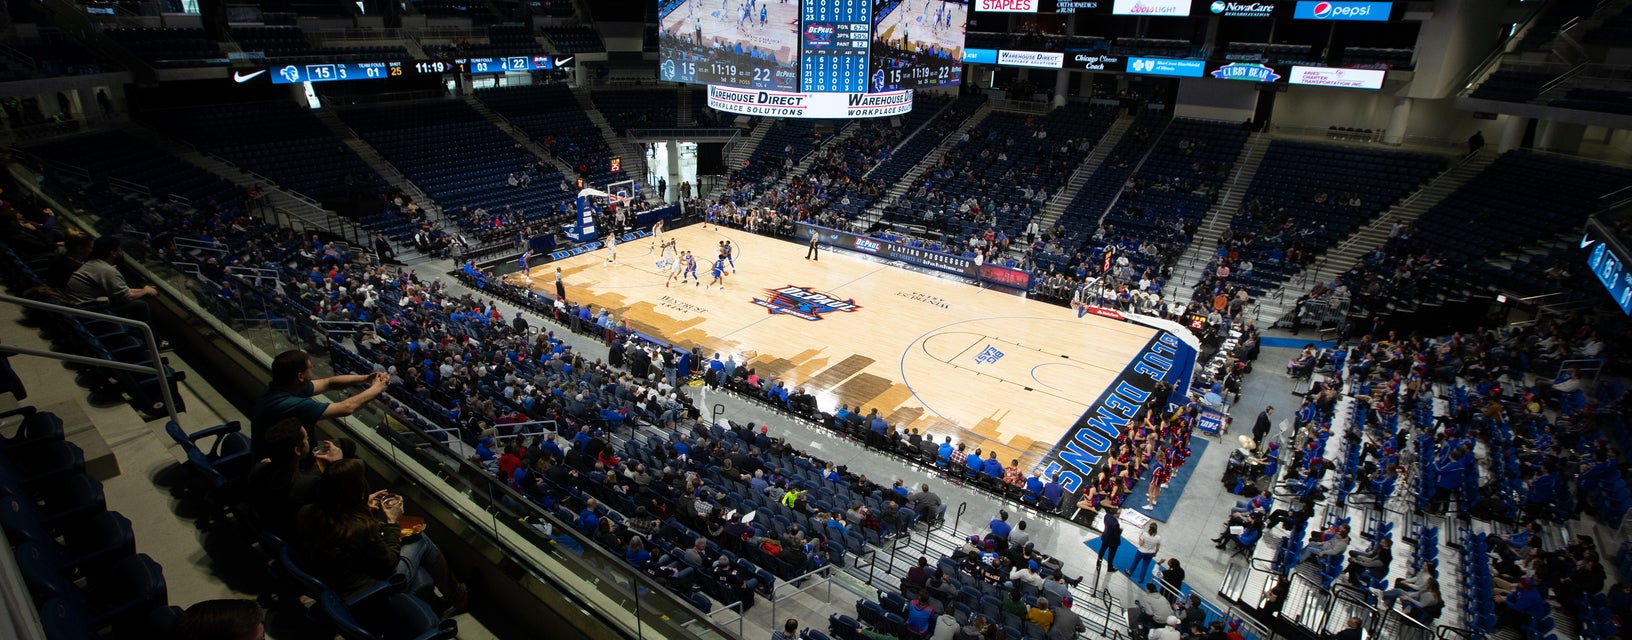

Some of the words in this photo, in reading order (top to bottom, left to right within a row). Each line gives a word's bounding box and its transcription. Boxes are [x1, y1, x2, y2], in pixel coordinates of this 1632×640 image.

[983, 0, 1030, 10] STAPLES
[1225, 2, 1274, 12] NovaCare
[1332, 5, 1371, 17] pepsi
[1002, 52, 1035, 60] WAREHOUSE
[415, 62, 444, 73] 11:19
[460, 64, 464, 72] 1
[477, 63, 487, 71] 03
[501, 62, 507, 70] 4
[513, 59, 524, 69] 22
[682, 62, 696, 75] 15
[711, 63, 737, 76] 11:19
[315, 67, 330, 78] 15
[340, 69, 347, 79] 3
[366, 67, 380, 77] 01
[390, 67, 402, 76] 25
[753, 68, 770, 81] 22
[891, 70, 901, 83] 15
[913, 67, 930, 78] 11:19
[938, 66, 949, 78] 22
[1223, 67, 1247, 76] CUBBY
[1248, 68, 1270, 79] BEAR
[711, 85, 755, 103] WAREHOUSE
[758, 92, 803, 105] DIRECT
[848, 94, 904, 106] WAREHOUSE
[711, 101, 743, 112] WORKPLACE
[747, 107, 803, 116] SOLUTIONS
[848, 107, 896, 116] WORKPLACE
[888, 244, 920, 256] PLAYING
[924, 252, 970, 268] POSSESSED
[1134, 332, 1178, 382] BLUE
[1043, 381, 1151, 494] DEMONS
